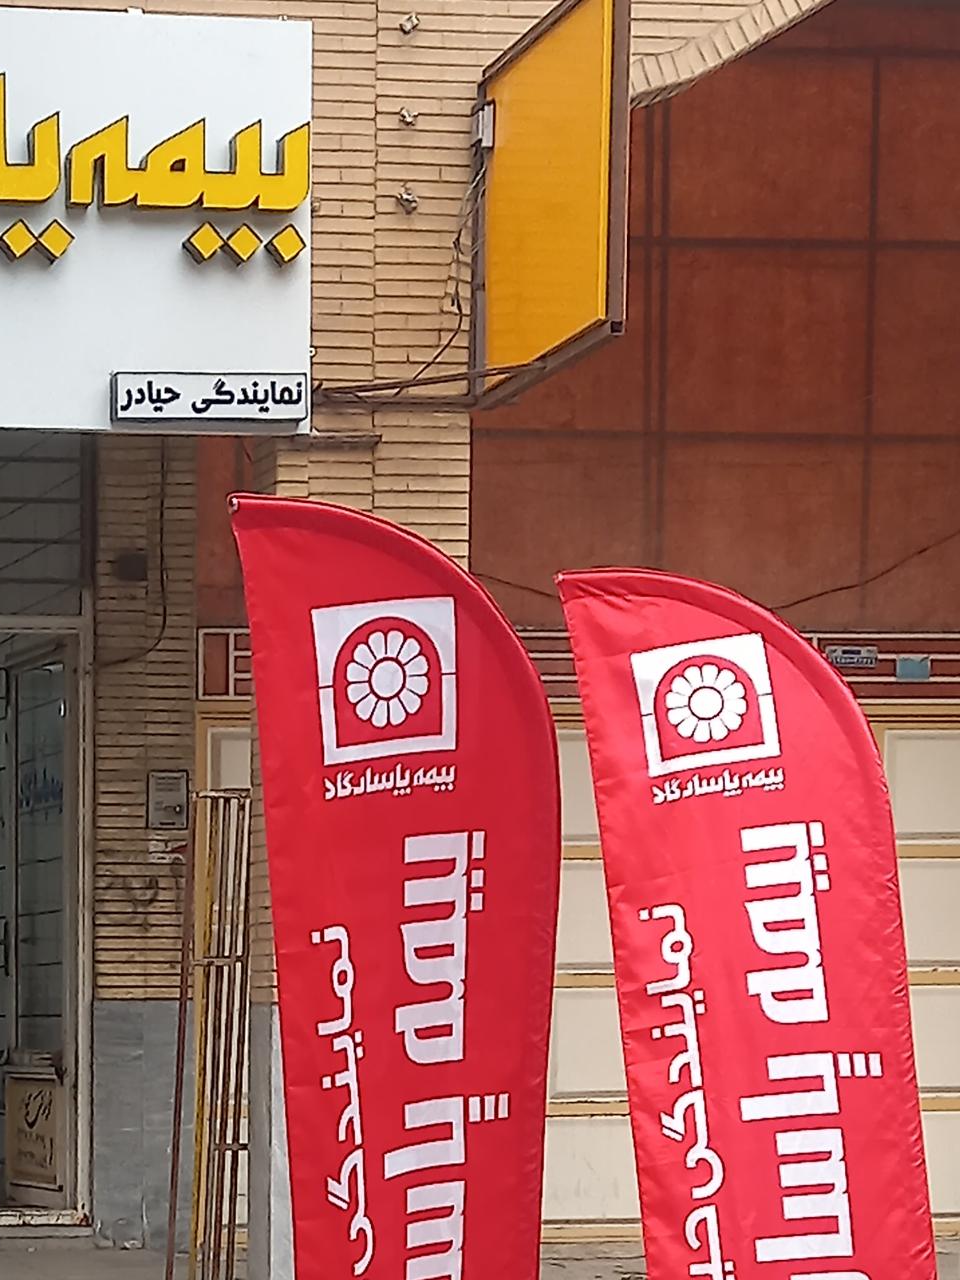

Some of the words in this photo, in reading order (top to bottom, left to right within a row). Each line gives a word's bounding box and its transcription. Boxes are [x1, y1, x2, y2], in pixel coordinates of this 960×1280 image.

[67, 116, 310, 266] بیمه
[120, 380, 181, 412] حیادر
[191, 378, 302, 414] نمایندگی
[324, 762, 411, 800] پاسارگاد
[413, 765, 455, 792] بیمه
[651, 769, 742, 804] پاسارگاد
[742, 767, 784, 791] بیمه
[741, 821, 830, 1024] بیمه
[395, 831, 485, 1064] بیمه
[639, 904, 725, 1199] نمایندگی
[311, 926, 376, 1276] نمایندگی
